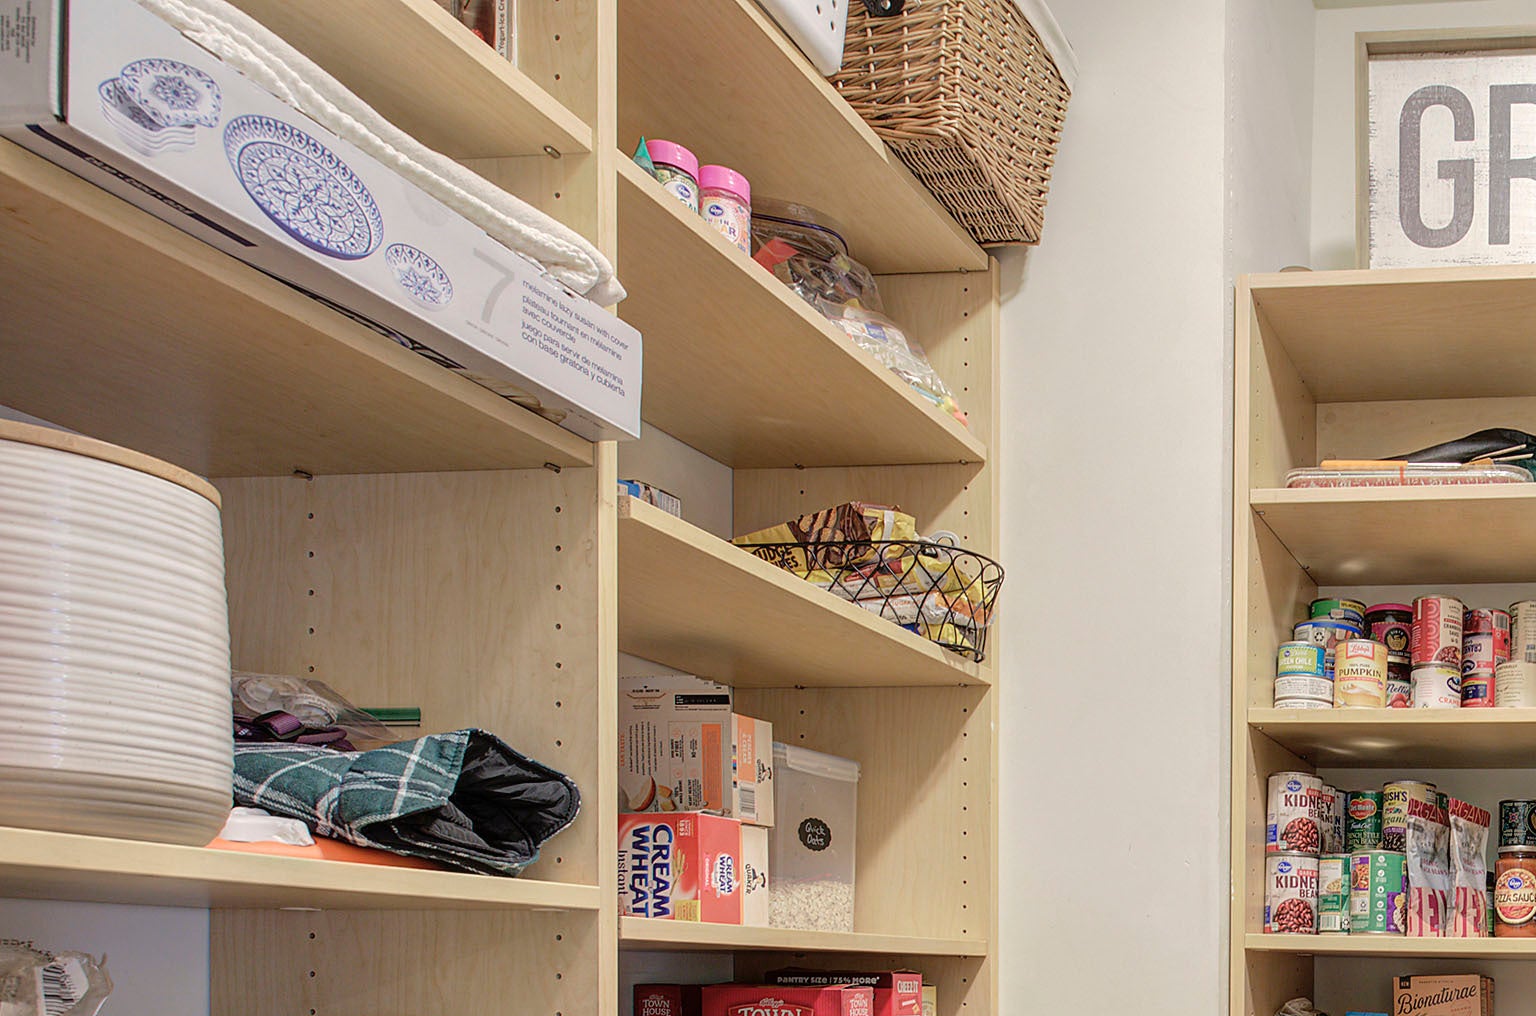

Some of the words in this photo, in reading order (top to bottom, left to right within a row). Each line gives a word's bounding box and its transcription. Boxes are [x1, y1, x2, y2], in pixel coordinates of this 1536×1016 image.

[473, 248, 515, 324] 7
[1338, 668, 1382, 679] PUMPKIN
[805, 823, 827, 837] Quick
[806, 835, 825, 847] Oats
[631, 824, 651, 918] WHEAT
[651, 824, 674, 918] CREAM
[719, 855, 727, 893] WHEAT
[726, 856, 734, 894] CREAM
[833, 976, 851, 984] 75%
[642, 999, 670, 1009] TOWN
[849, 999, 869, 1009] TOWN
[1397, 984, 1478, 1015] Bionaturae
